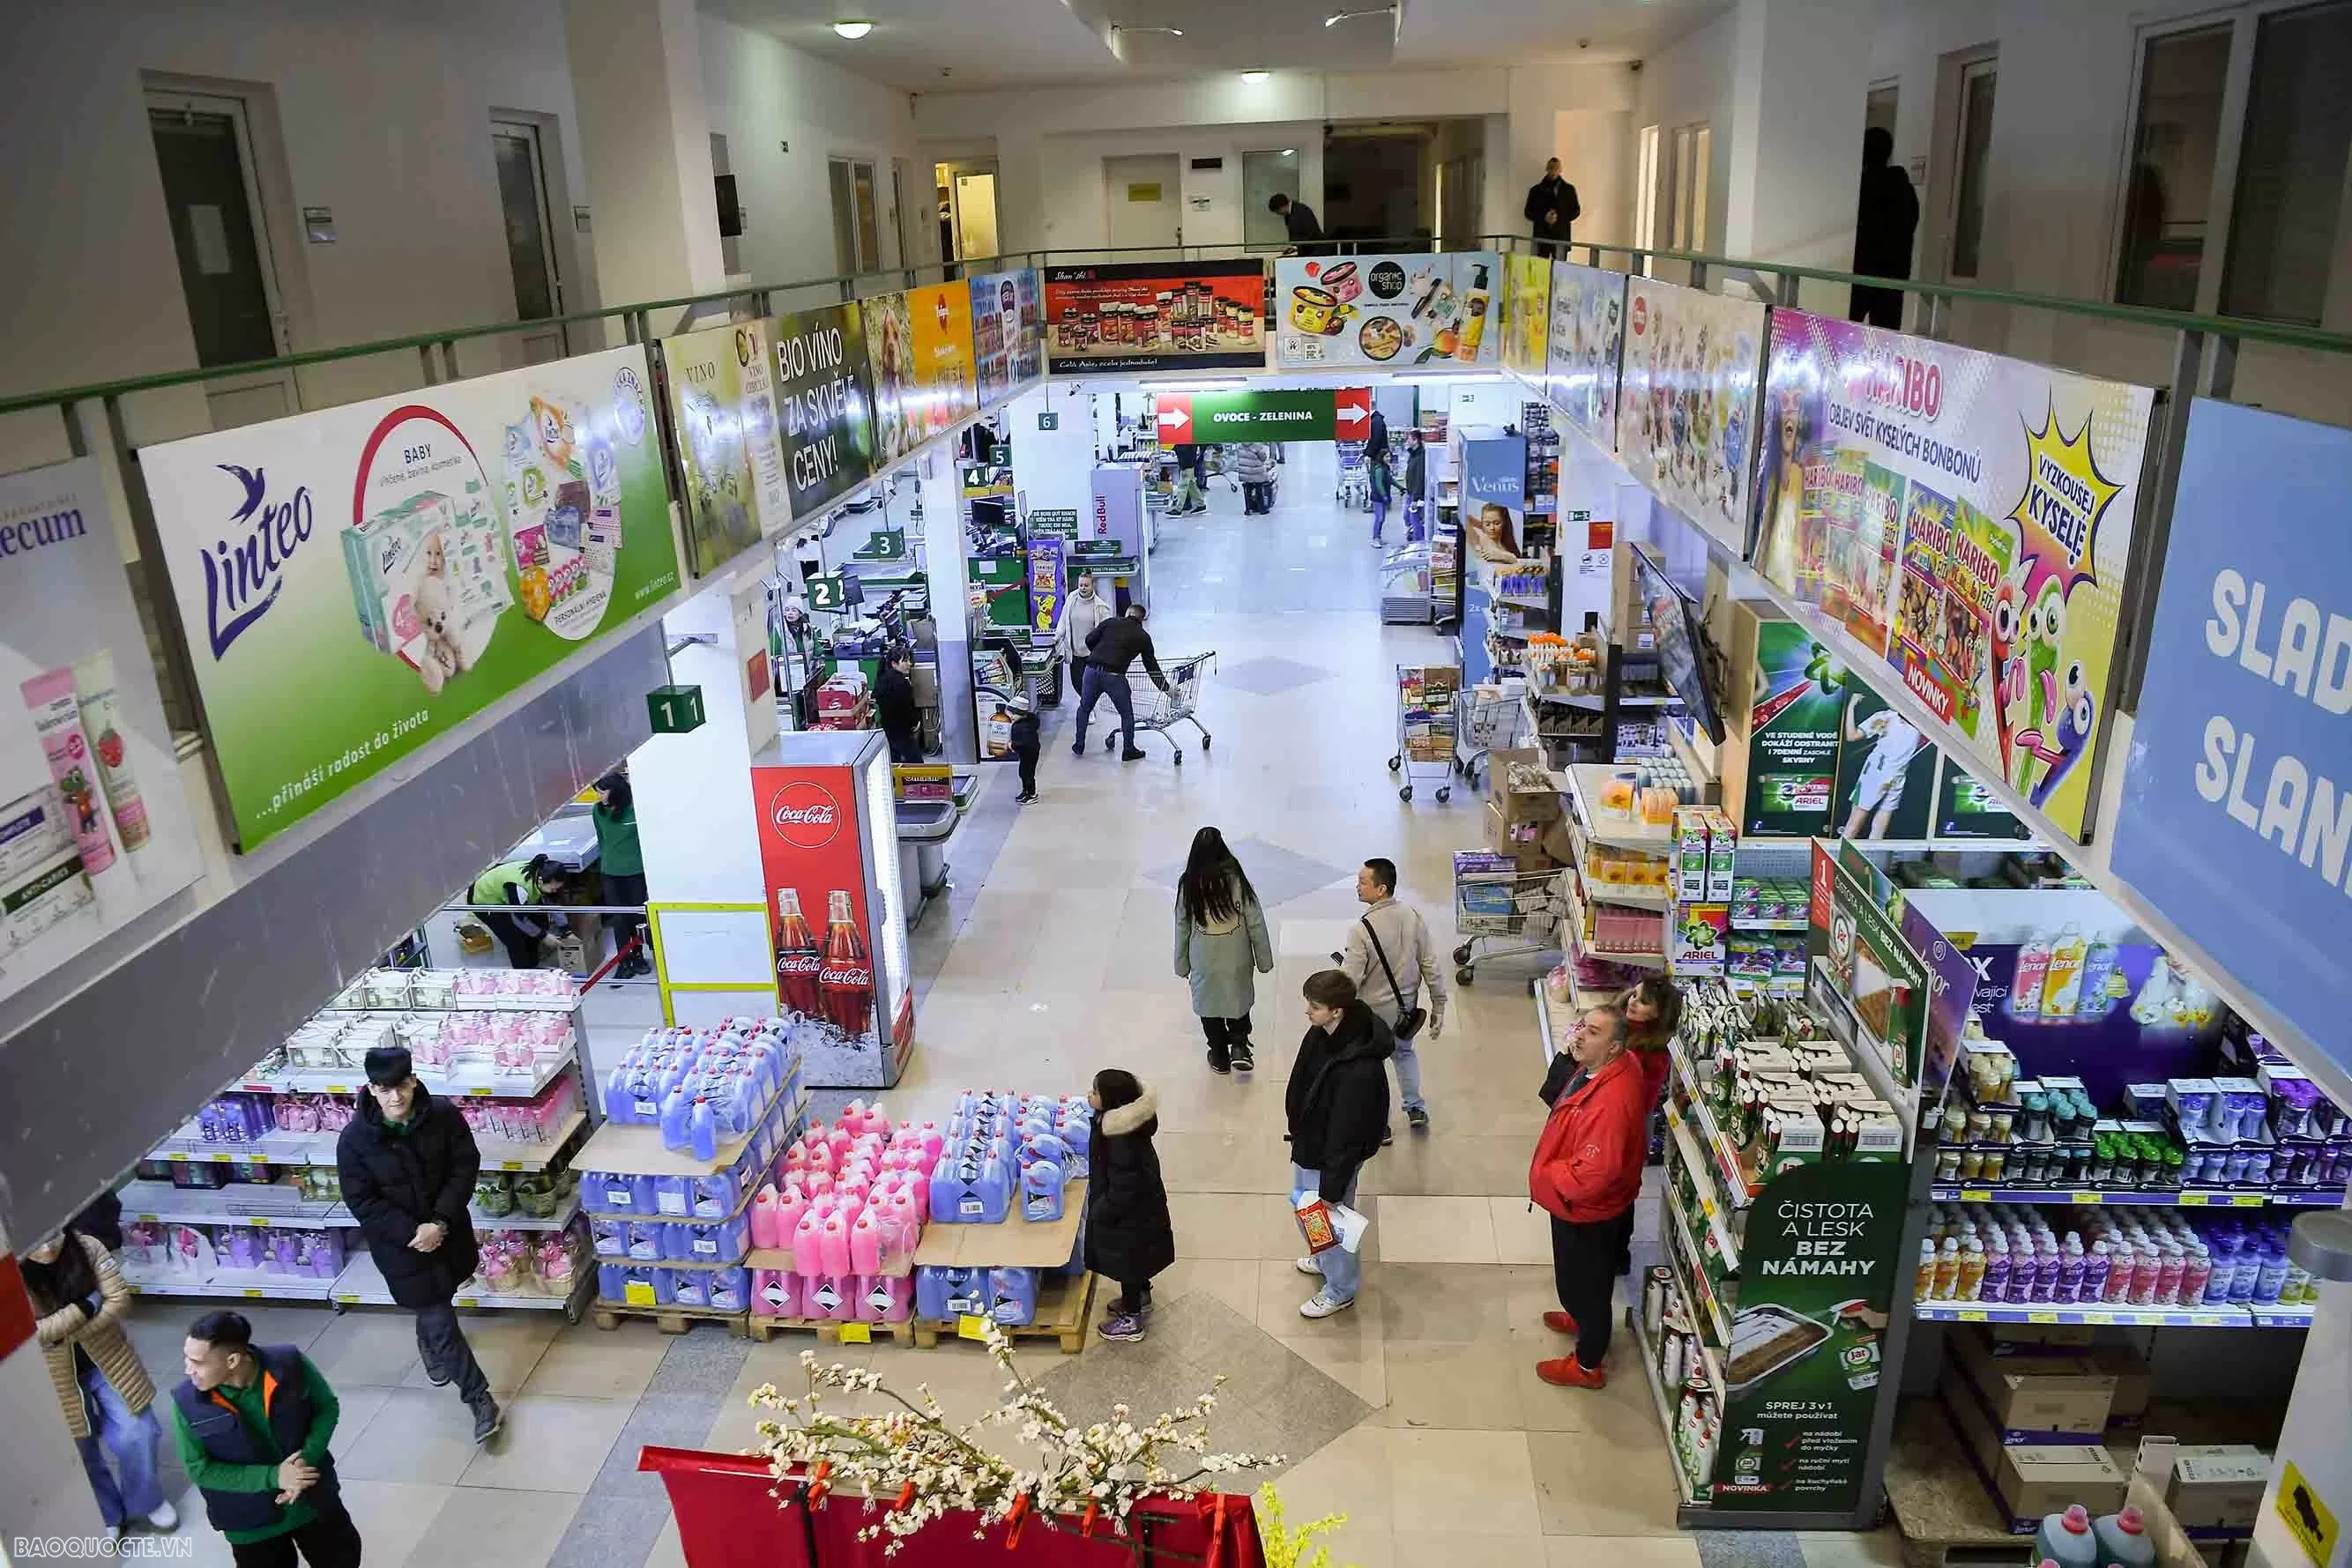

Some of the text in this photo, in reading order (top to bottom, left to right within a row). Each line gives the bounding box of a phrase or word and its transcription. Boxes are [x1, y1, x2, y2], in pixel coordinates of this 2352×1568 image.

[777, 322, 843, 382] BIO VÍNO
[1042, 416, 1051, 428] 6
[1213, 412, 1250, 423] OVOCE
[1259, 411, 1313, 422] ZELENINA
[404, 444, 432, 464] BABY
[1828, 404, 1981, 483] OBJEV SVĚT KYSELÝCH BONBONŮ
[793, 435, 838, 492] CENY!
[995, 450, 1005, 464] 5
[968, 468, 979, 486] 4
[2038, 455, 2095, 516] VYZKOUŠEJ
[0, 509, 87, 558] ecum
[1911, 510, 1952, 558] HARIBO
[880, 536, 890, 555] 3
[1954, 530, 2000, 592] HARIBO
[199, 486, 314, 662] Linteo
[814, 583, 830, 605] 2
[2205, 568, 2352, 716] SLAD
[1907, 665, 1950, 716] NOVINKY
[660, 703, 674, 727] 1
[690, 697, 700, 721] 1
[327, 741, 371, 777] radost
[374, 732, 389, 749] do
[393, 710, 430, 739] života
[776, 805, 833, 826] Coca-Cola
[2195, 715, 2352, 900] SLAN
[778, 955, 821, 973] Coca-Cola
[1682, 951, 1718, 960] ARIEL
[2049, 958, 2081, 970] Lenor
[819, 966, 870, 987] Coca-Cola
[1777, 1200, 1874, 1219] ČISTOTA
[1782, 1222, 1866, 1237] A LESK
[1796, 1241, 1848, 1256] BEZ
[1763, 1258, 1876, 1274] NÁMAHY
[1765, 1401, 1805, 1410] SPREJ
